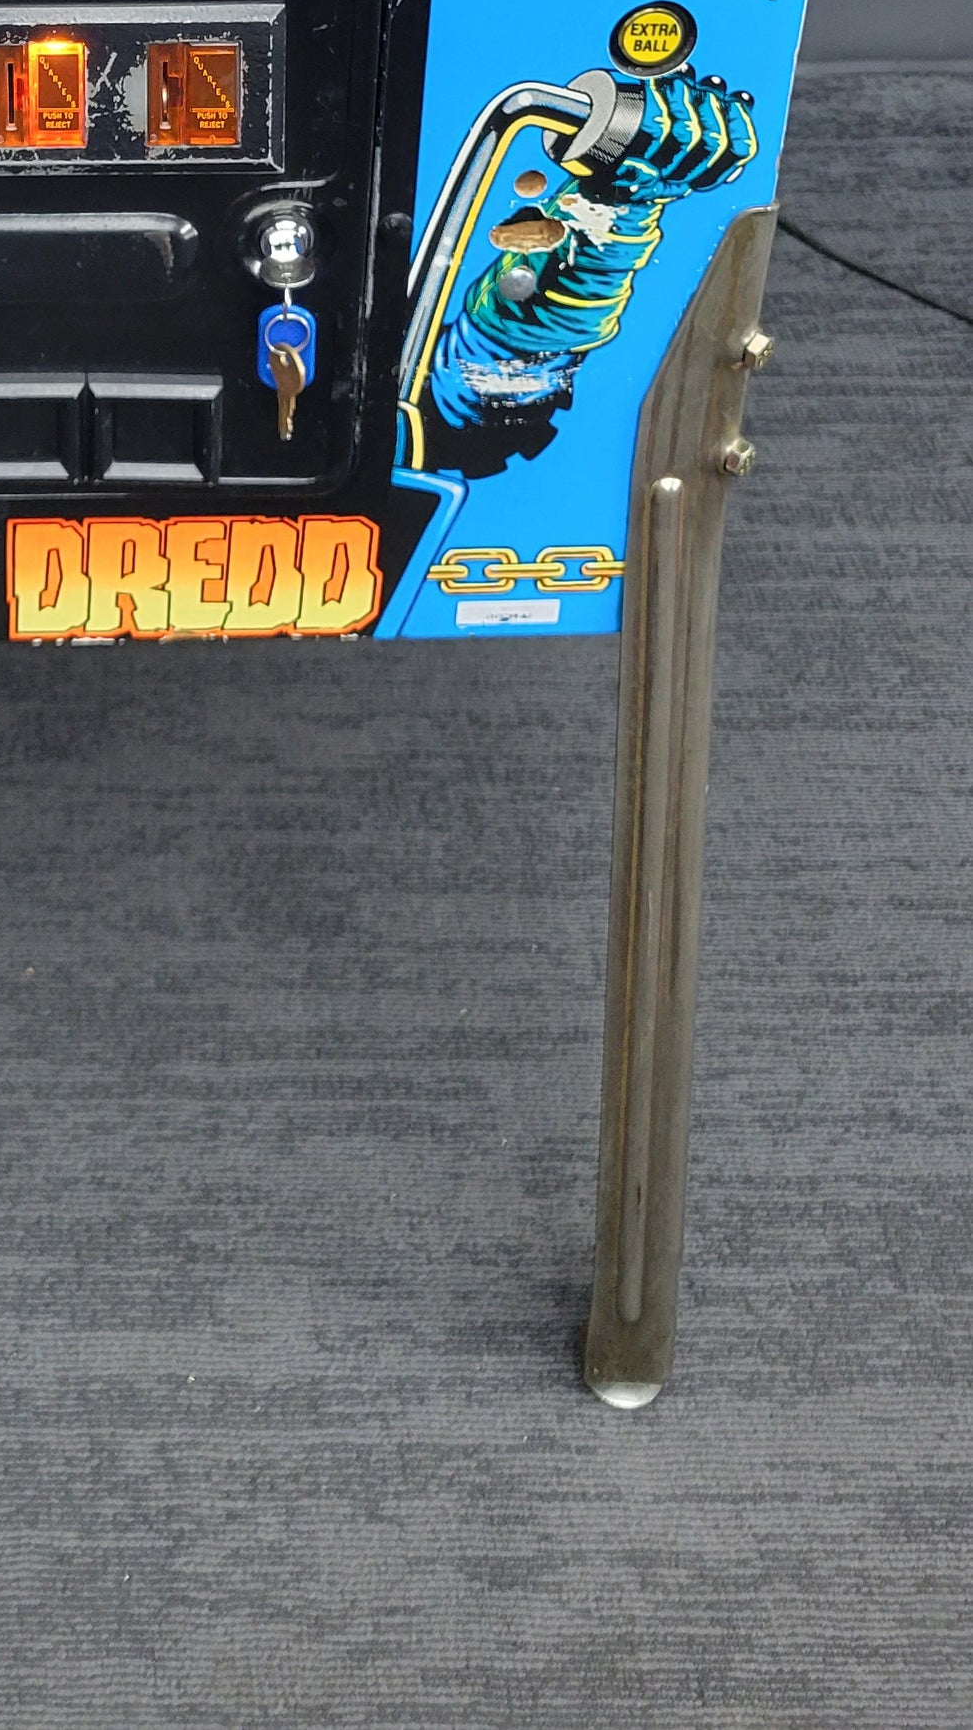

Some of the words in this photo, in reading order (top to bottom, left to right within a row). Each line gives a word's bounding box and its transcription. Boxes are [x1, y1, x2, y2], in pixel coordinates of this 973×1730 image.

[630, 22, 678, 38] EXTRA
[633, 38, 669, 53] BALL
[39, 56, 76, 108] QUARTERS
[193, 56, 230, 108] QUARTERS
[43, 112, 62, 120] PUSH
[64, 112, 74, 120] TO
[197, 112, 216, 120] PUSH
[218, 112, 228, 120] TO
[45, 121, 71, 129] REJECT
[199, 121, 225, 129] REJECT
[6, 515, 384, 642] DREDD
